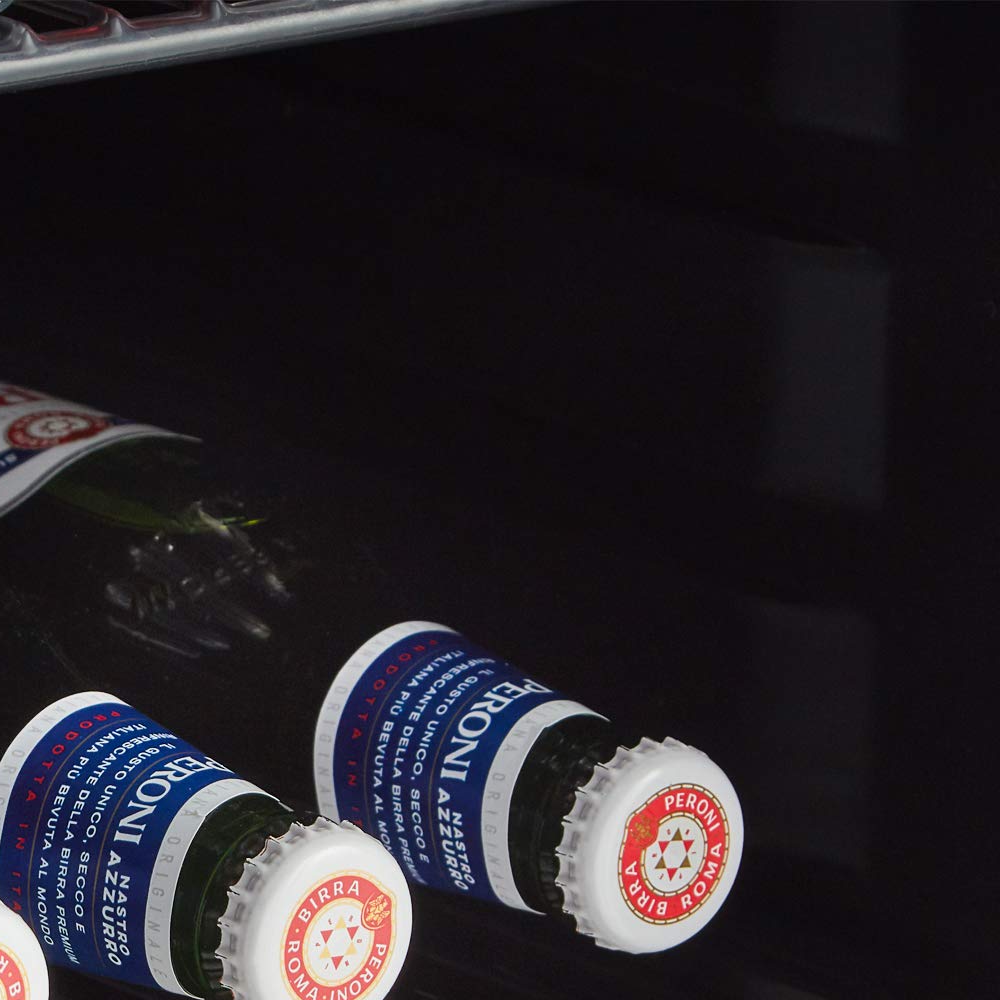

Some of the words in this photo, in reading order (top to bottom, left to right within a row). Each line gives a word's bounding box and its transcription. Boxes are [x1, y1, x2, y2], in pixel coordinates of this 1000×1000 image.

[408, 650, 464, 687] ITALIANA
[436, 674, 478, 715] GUSTO
[26, 710, 120, 801] PRODOTTA
[87, 724, 146, 753] ITALIANA
[373, 721, 394, 788] BEVUTA
[392, 724, 414, 778] DELLA
[440, 678, 554, 782] PERONI
[115, 748, 160, 779] GUSTO
[42, 784, 70, 850] BEVUTA
[64, 788, 90, 841] DELLA
[114, 755, 234, 845] PERONI
[374, 794, 381, 813] AL
[391, 785, 404, 834] BIRRA
[410, 789, 426, 849] SECCO
[664, 792, 721, 832] PERONI
[16, 823, 29, 849] IN
[420, 852, 430, 863] E
[438, 788, 469, 890] AZZURRO
[452, 812, 475, 884] NASTRO
[38, 857, 48, 880] AL
[55, 848, 71, 900] BIRRA
[74, 852, 90, 918] SECCO
[625, 861, 668, 915] BIRRA
[680, 842, 722, 909] ROMA
[37, 888, 54, 945] MONDO
[76, 922, 86, 933] E
[101, 850, 122, 966] AZZURRO
[117, 876, 130, 956] NASTRO
[299, 880, 360, 923] BIRRA
[56, 904, 80, 965] PREMIUM
